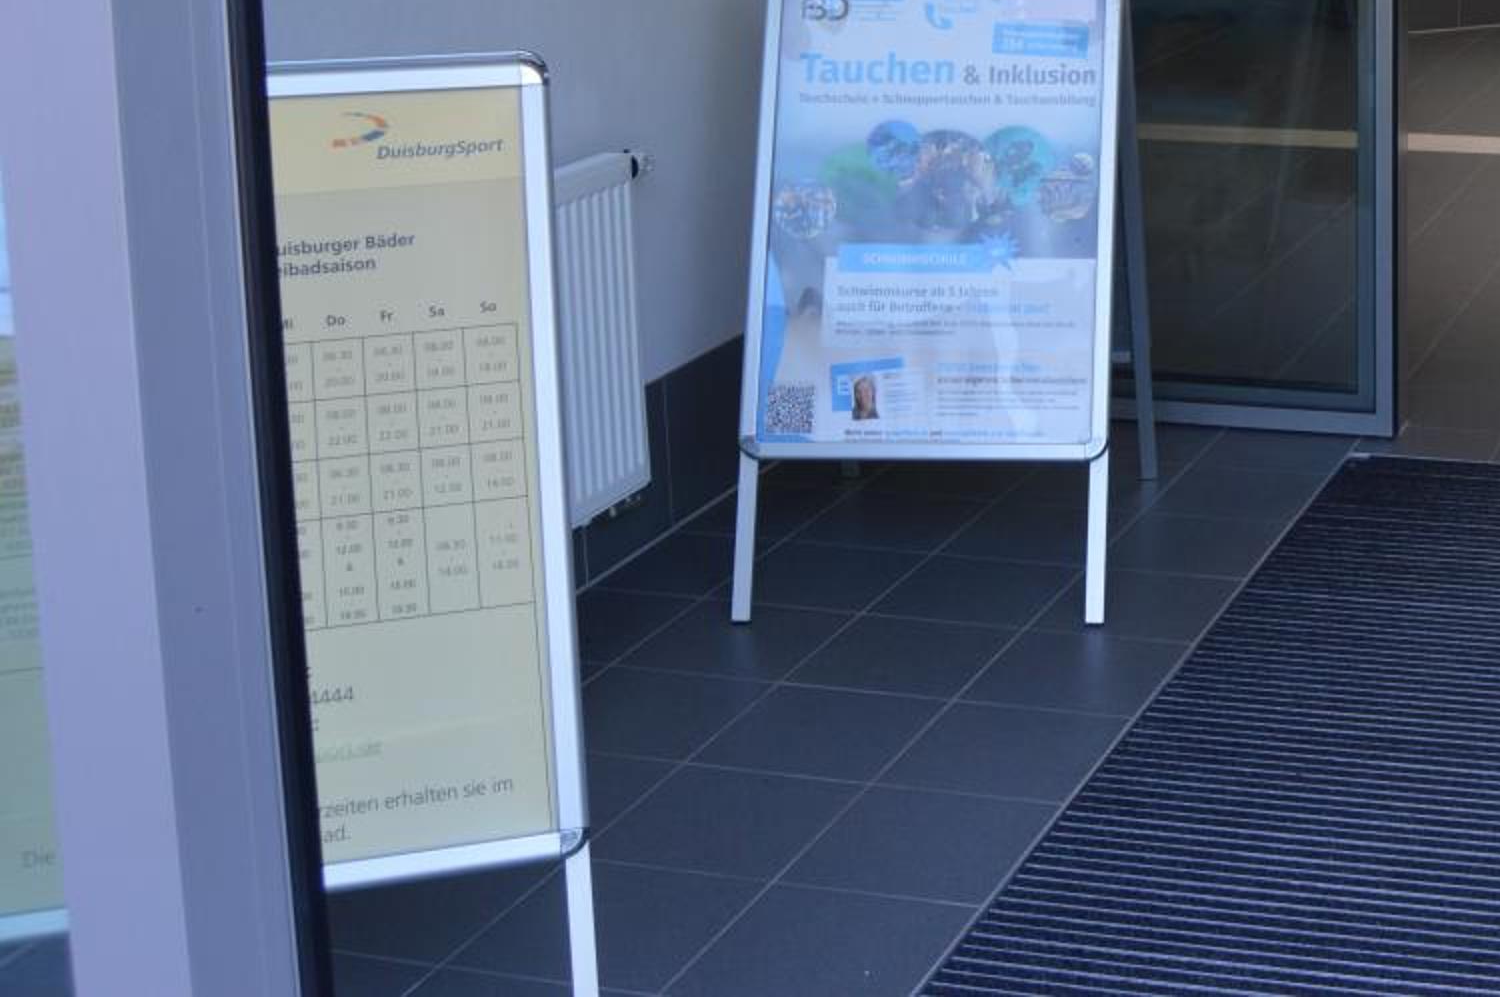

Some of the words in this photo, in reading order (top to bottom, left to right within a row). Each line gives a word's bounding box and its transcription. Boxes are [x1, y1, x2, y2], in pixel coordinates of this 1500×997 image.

[800, 52, 955, 85] Tauchen
[963, 65, 980, 85] &
[989, 62, 1096, 86] Inklusion
[377, 138, 505, 161] DuisburgSport
[277, 239, 360, 257] uisburger
[365, 233, 415, 250] Bäder
[280, 258, 377, 277] ibadsaison
[326, 315, 346, 327] Do
[380, 309, 394, 322] Fr
[429, 305, 445, 318] Sa
[479, 301, 497, 314] So
[868, 300, 885, 313] für
[320, 797, 379, 819] zeiten
[385, 784, 459, 810] erhalten
[463, 780, 487, 798] sie
[493, 776, 514, 794] im
[324, 822, 352, 844] ad.
